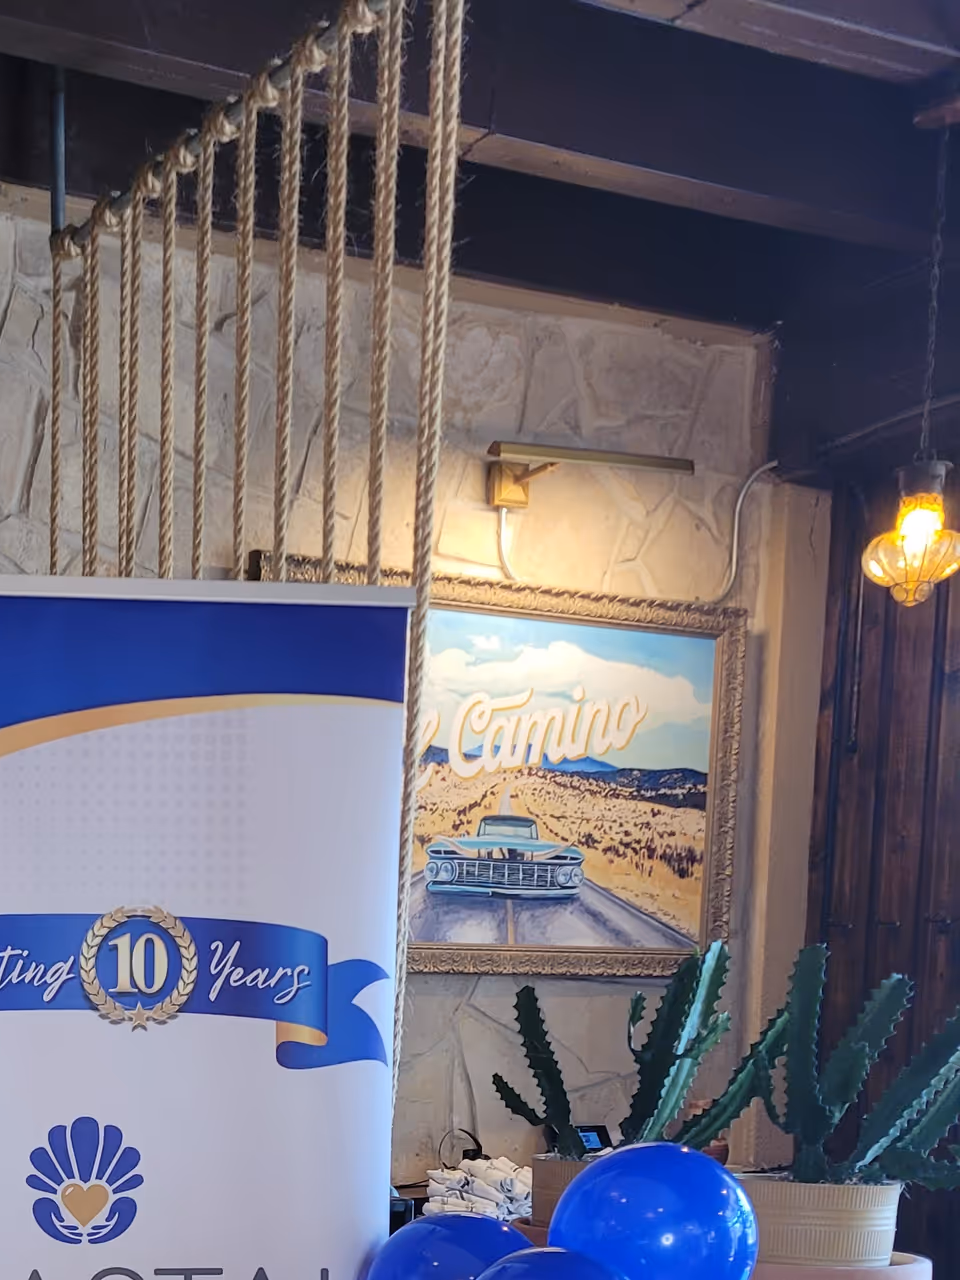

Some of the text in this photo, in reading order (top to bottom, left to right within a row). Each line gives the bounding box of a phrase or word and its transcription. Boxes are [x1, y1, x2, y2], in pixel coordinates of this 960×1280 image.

[447, 686, 648, 780] Camino
[107, 932, 169, 996] 10
[209, 940, 312, 1004] Years
